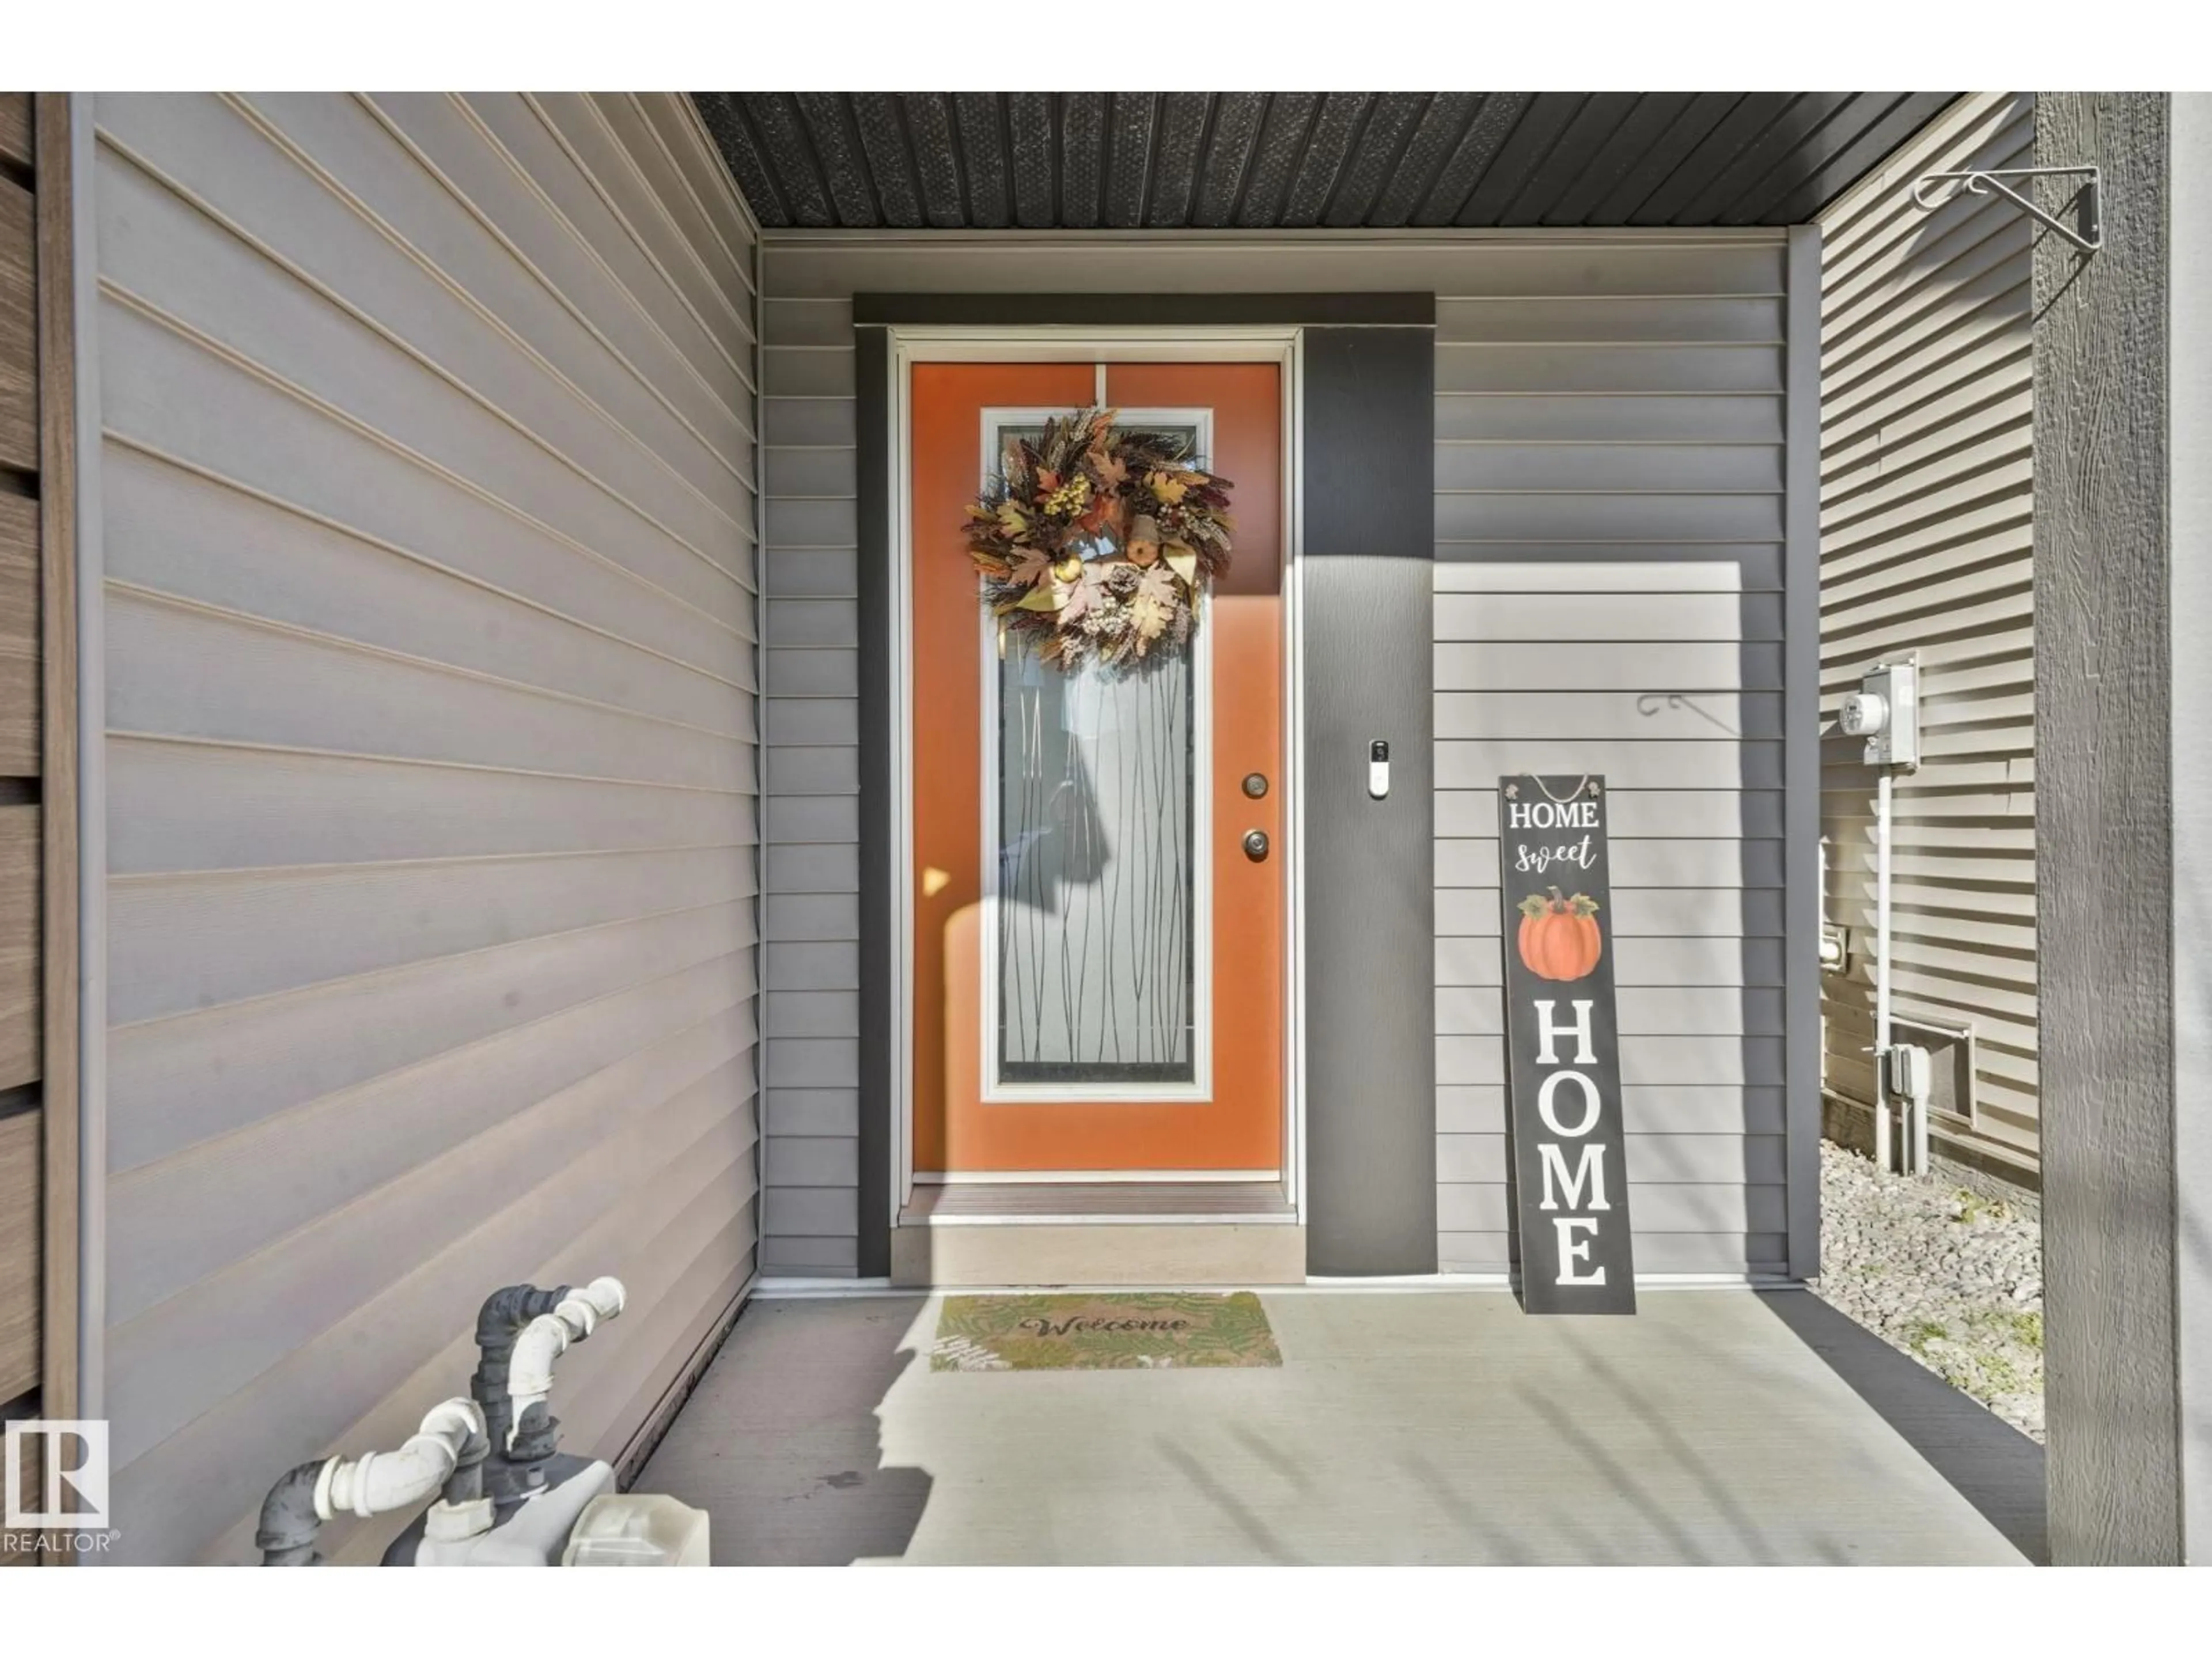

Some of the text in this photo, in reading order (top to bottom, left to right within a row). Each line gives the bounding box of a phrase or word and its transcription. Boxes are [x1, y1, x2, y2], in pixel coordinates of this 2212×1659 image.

[1509, 802, 1600, 828] HOME
[1515, 834, 1597, 873] sweet
[1533, 999, 1611, 1286] HOME
[1019, 1316, 1190, 1337] Welcome
